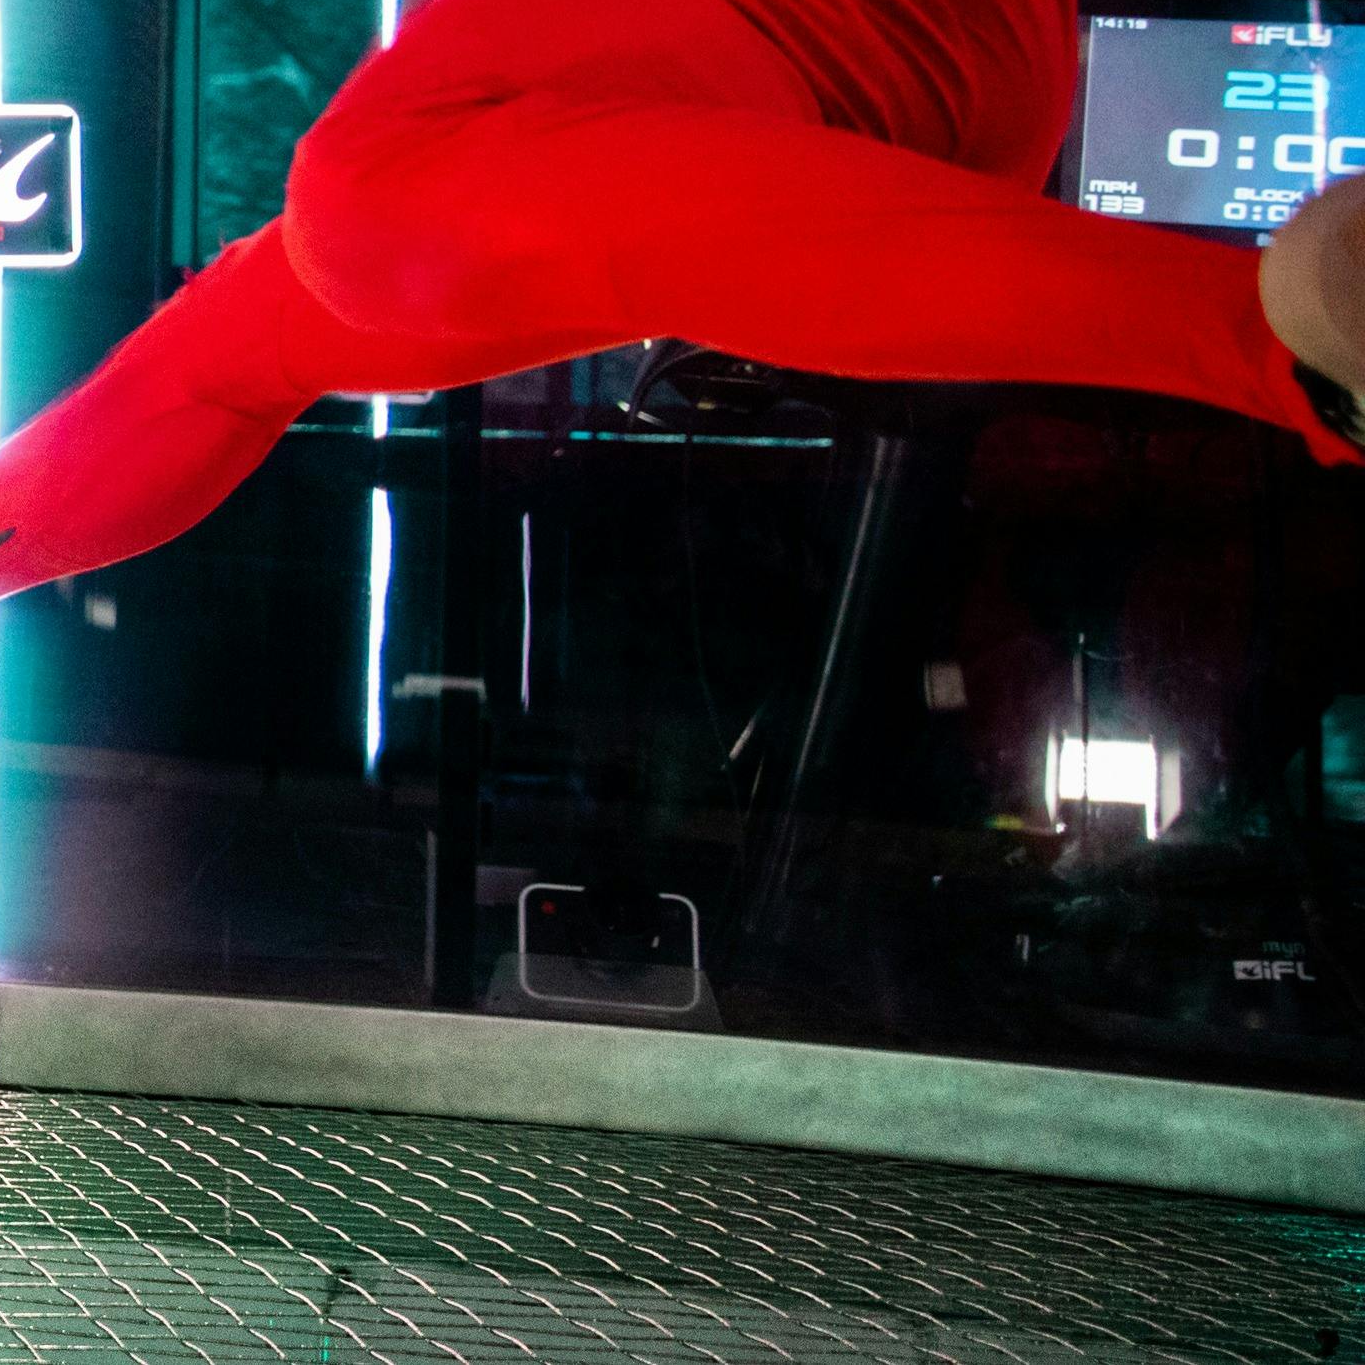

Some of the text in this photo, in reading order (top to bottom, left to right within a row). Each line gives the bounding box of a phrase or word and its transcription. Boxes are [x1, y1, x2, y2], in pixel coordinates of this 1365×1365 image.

[1223, 71, 1331, 112] 23
[1084, 195, 1145, 215] 133
[1234, 188, 1305, 203] BLOCK
